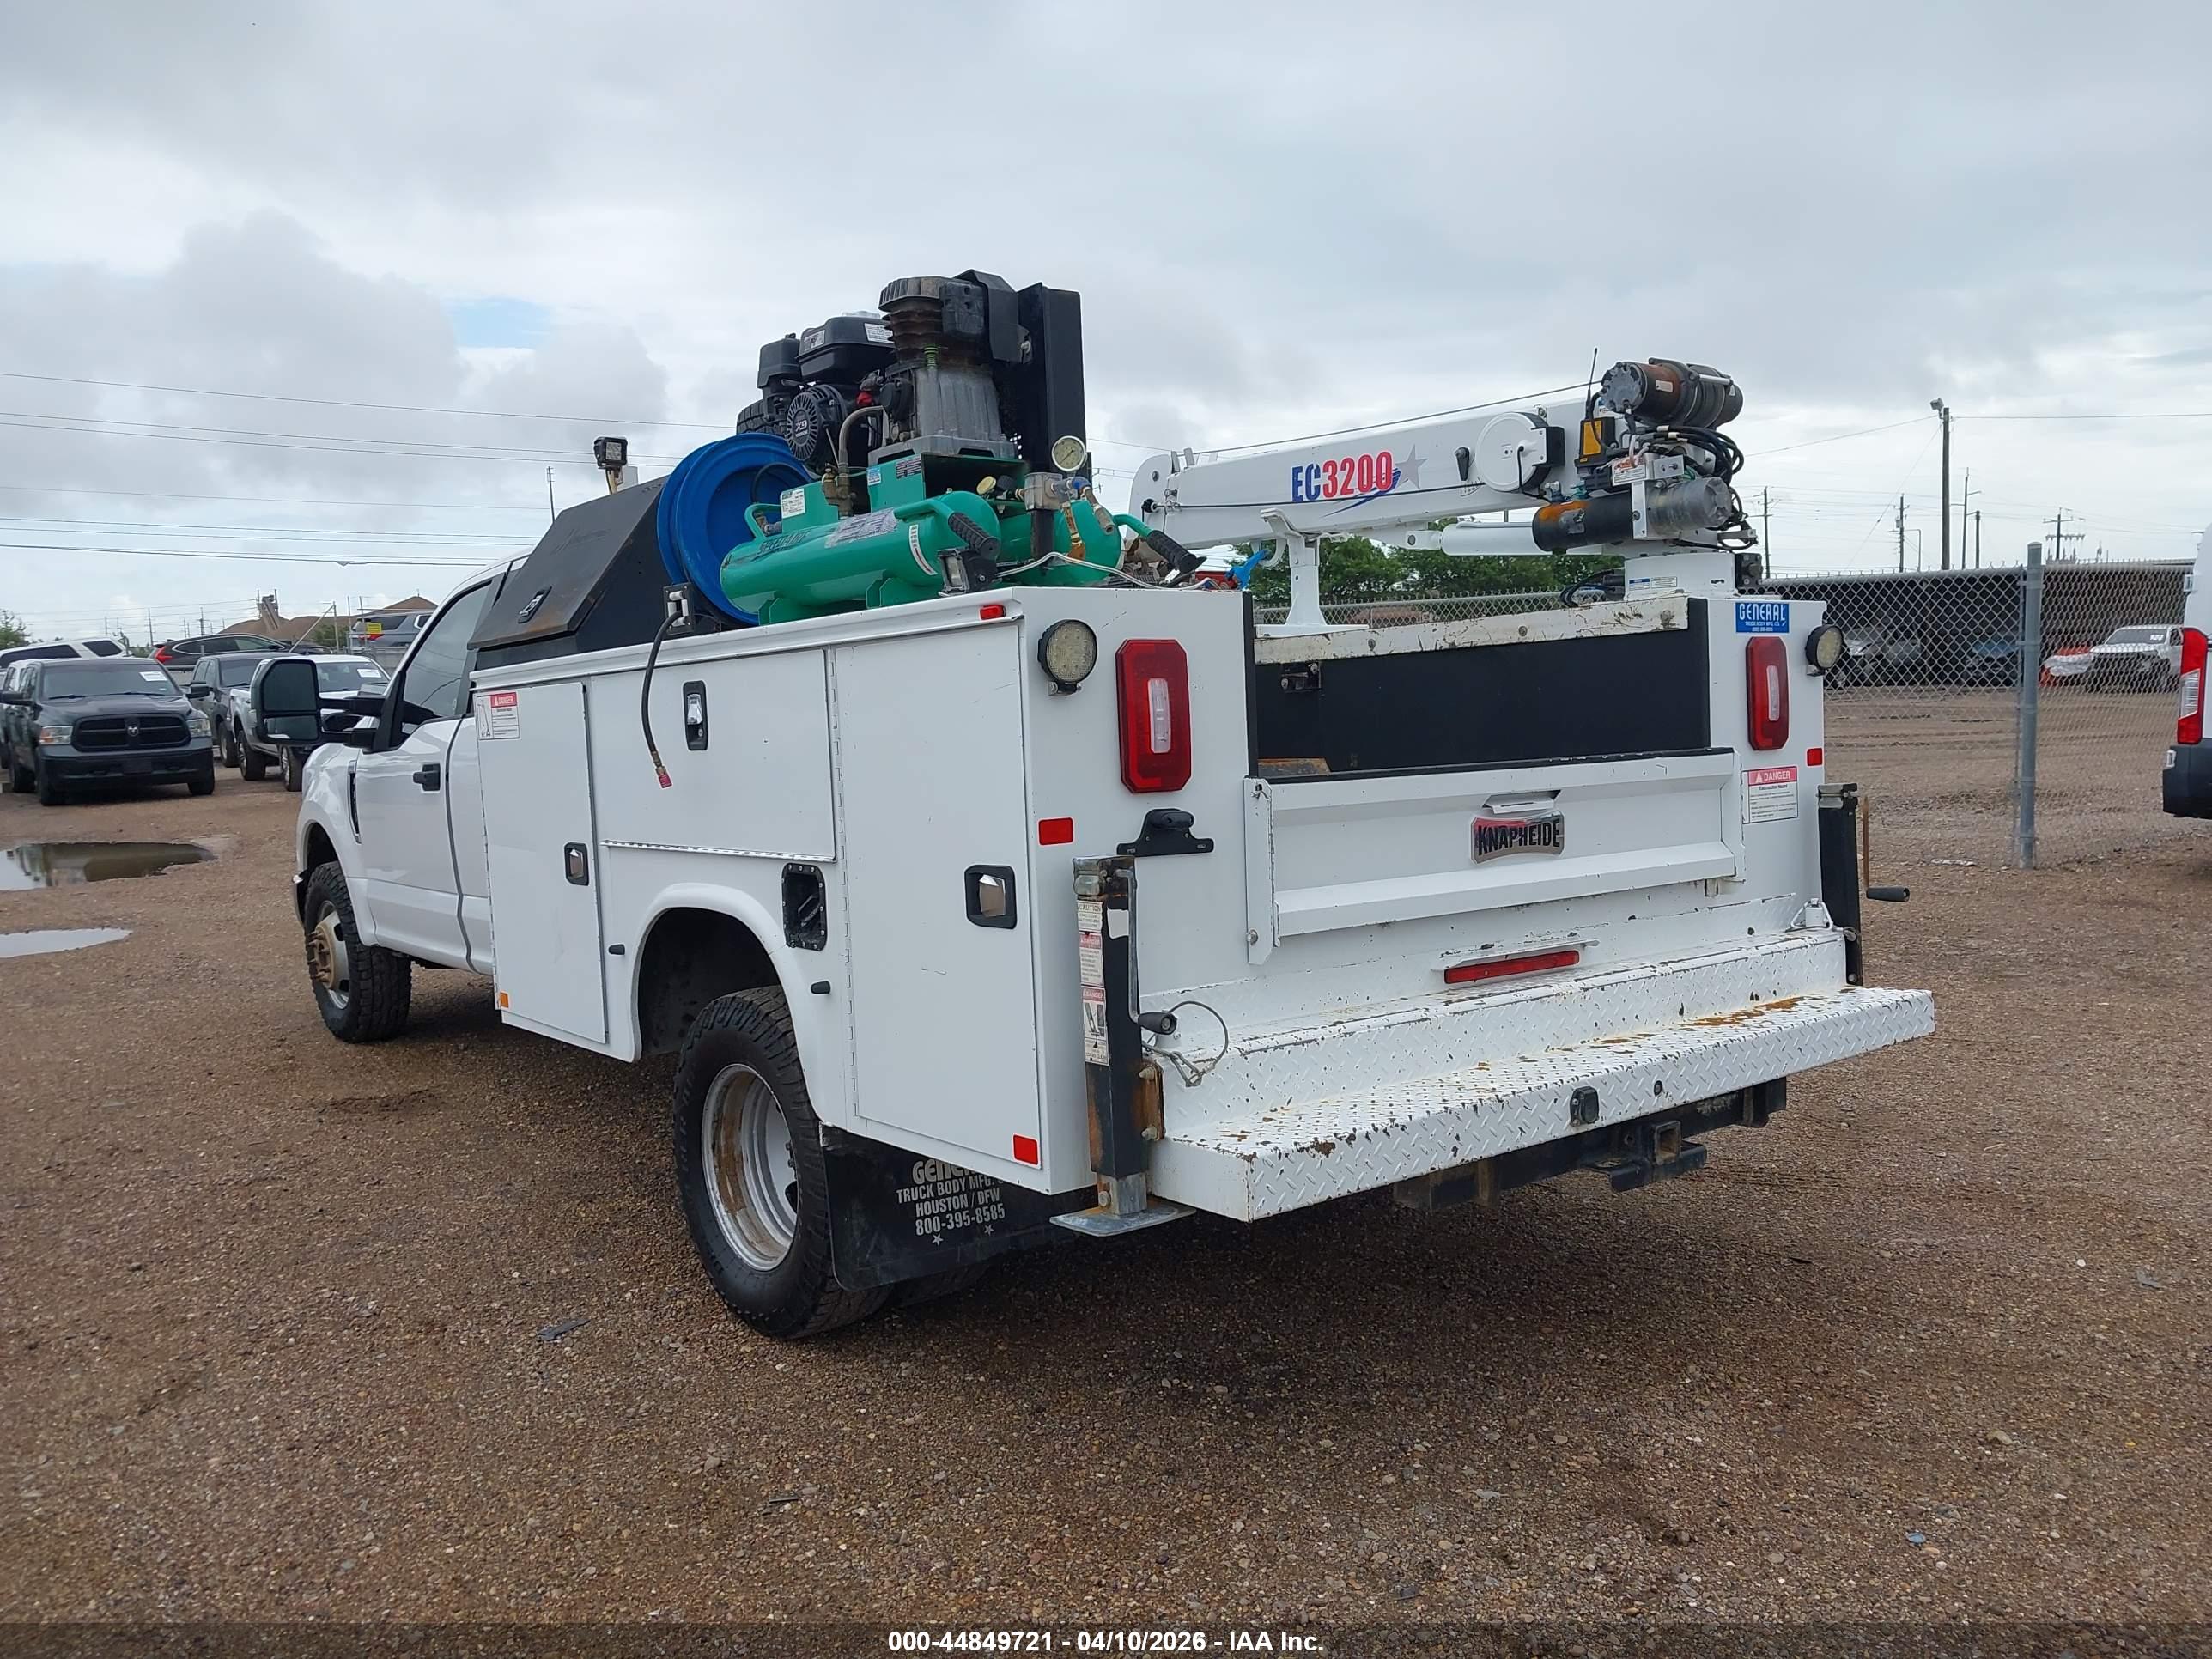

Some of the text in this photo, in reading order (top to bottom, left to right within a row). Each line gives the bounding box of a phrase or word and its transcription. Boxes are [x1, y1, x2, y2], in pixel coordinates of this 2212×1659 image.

[1291, 451, 1393, 503] EC3200
[1739, 603, 1786, 621] GENERAL
[1764, 770, 1790, 781] DANGER
[1478, 817, 1560, 856] KNAPHEIDE
[1079, 902, 1101, 912] CAUTION
[896, 1183, 934, 1203] TRUCK
[937, 1176, 966, 1196] BODY
[915, 1187, 1000, 1218] HOUSTON / DFW
[915, 1203, 1006, 1236] 800-395-8585
